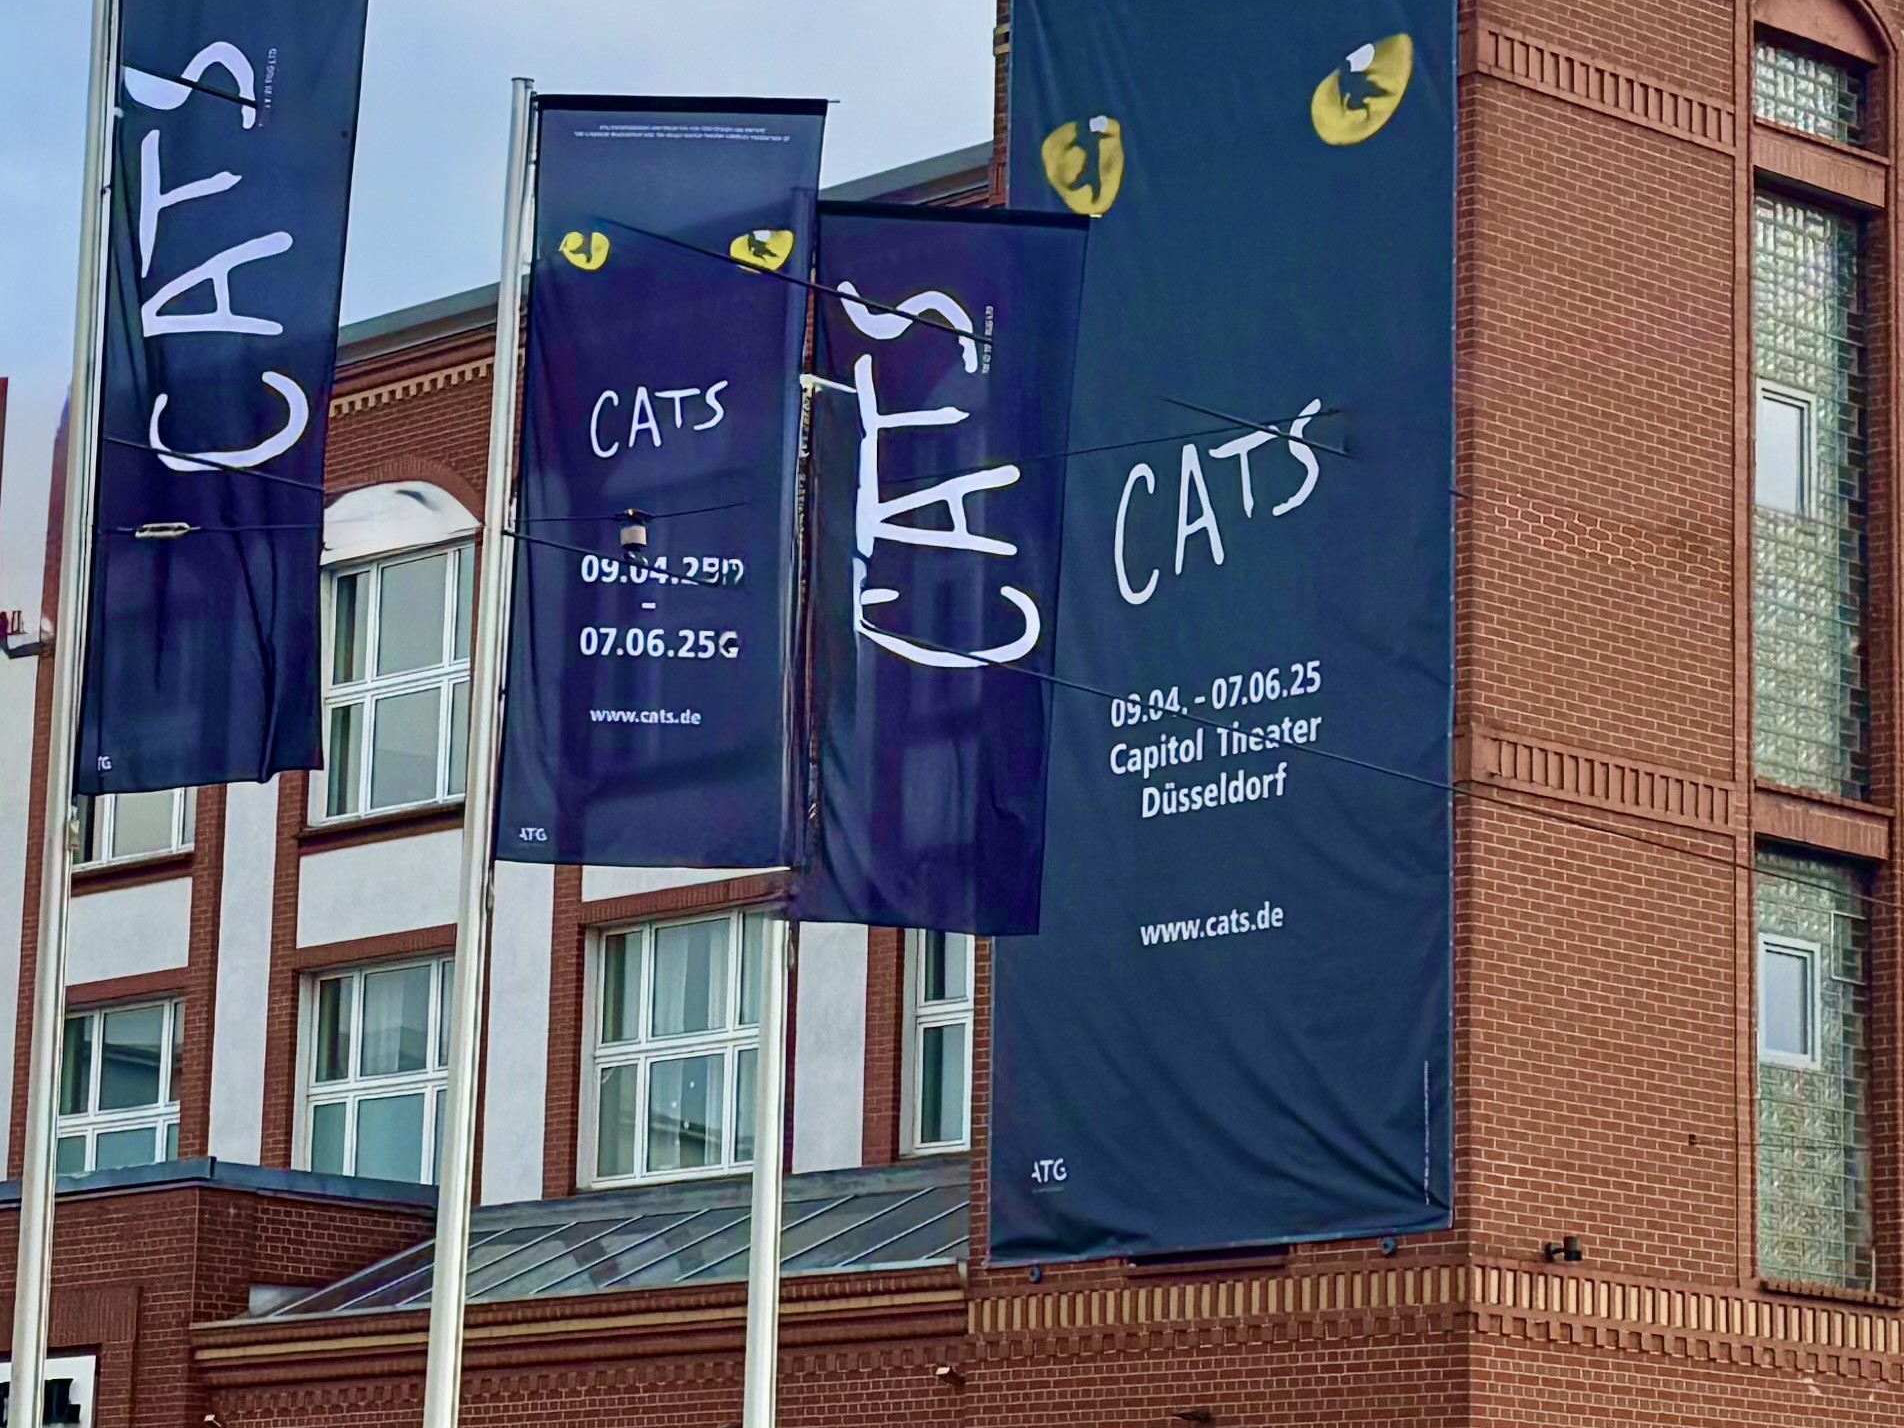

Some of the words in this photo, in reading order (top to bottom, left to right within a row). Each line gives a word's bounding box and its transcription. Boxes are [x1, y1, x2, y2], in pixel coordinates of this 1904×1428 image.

[123, 40, 310, 473] CATS
[590, 379, 729, 459] CATS
[836, 280, 1041, 669] CATS
[1114, 398, 1322, 605] CATS
[1211, 659, 1322, 710] 07.06.25
[1109, 726, 1205, 780] Capitol
[1216, 715, 1323, 758] Theater
[1141, 761, 1288, 819] Düsseldorf
[1139, 900, 1285, 947] www.cats.de
